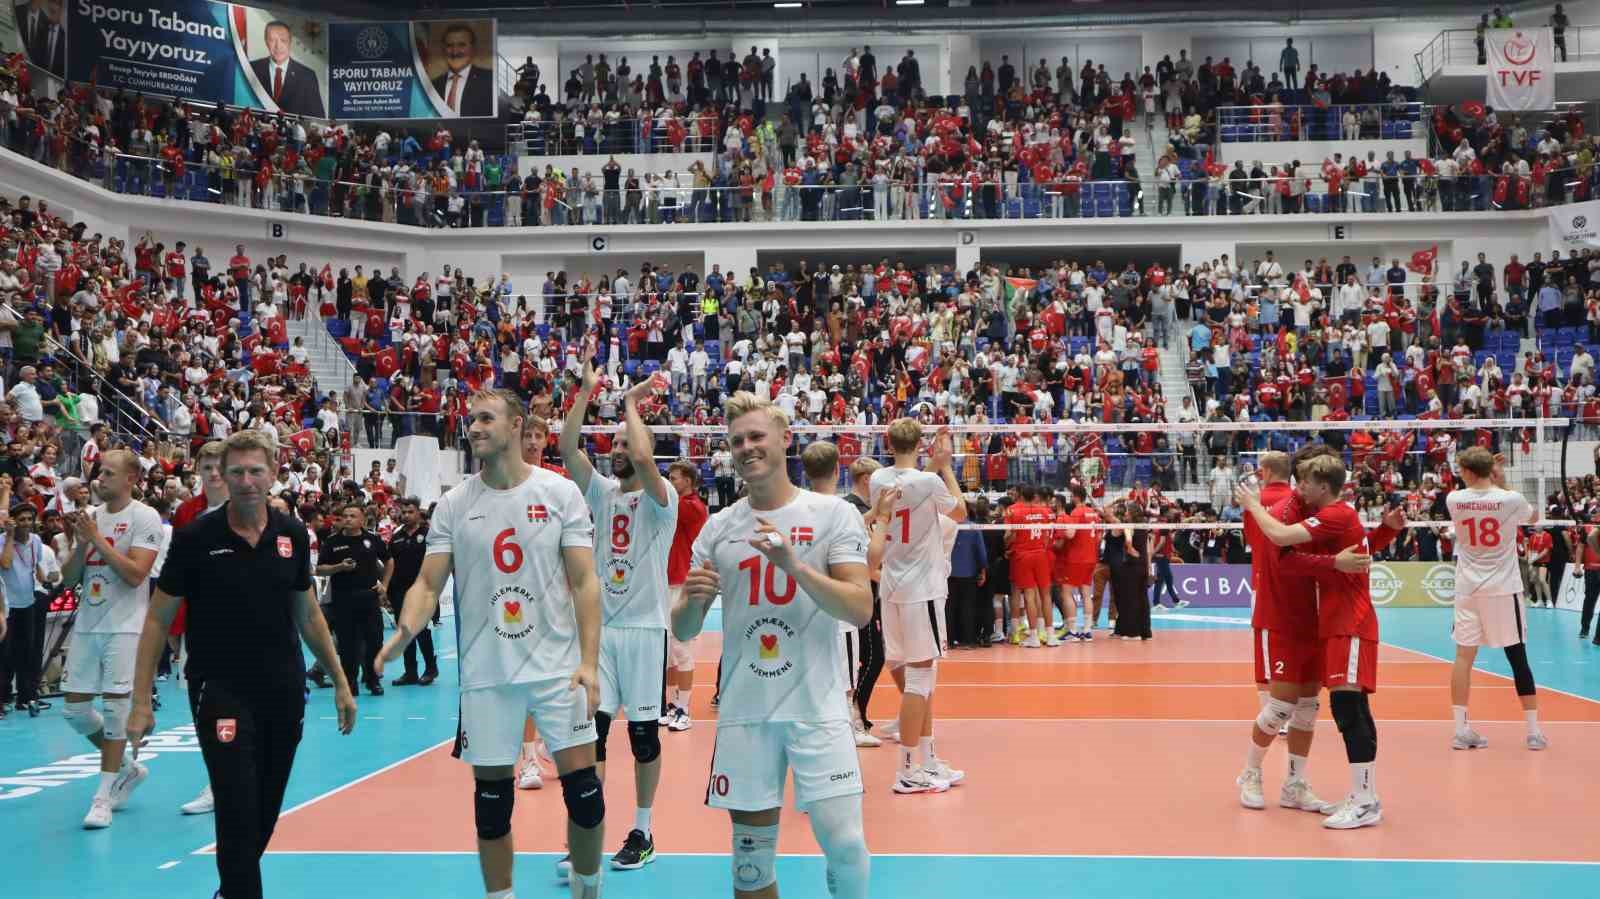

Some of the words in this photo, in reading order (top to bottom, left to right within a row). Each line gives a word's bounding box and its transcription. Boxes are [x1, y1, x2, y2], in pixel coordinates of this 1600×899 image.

[77, 0, 143, 25] Sporu
[148, 8, 226, 41] Tabana
[100, 28, 212, 65] Yayıyoruz.
[332, 67, 369, 79] SPORU
[370, 66, 414, 78] TABANA
[1497, 70, 1542, 87] TVF
[343, 80, 404, 92] YAYIYORUZ
[272, 223, 283, 238] B
[961, 231, 974, 246] D
[1334, 225, 1345, 240] E
[592, 236, 605, 251] C
[611, 514, 630, 553] 8
[1461, 516, 1501, 547] 18
[493, 527, 524, 574] 6
[737, 554, 797, 606] 10
[494, 624, 535, 640] HJEMMENE
[745, 616, 795, 640] JULEMÆRKE
[749, 659, 793, 678] HJEMMENE
[1274, 661, 1285, 674] 2
[461, 730, 469, 749] 6
[711, 773, 730, 797] 10
[830, 770, 855, 782] CRAFT
